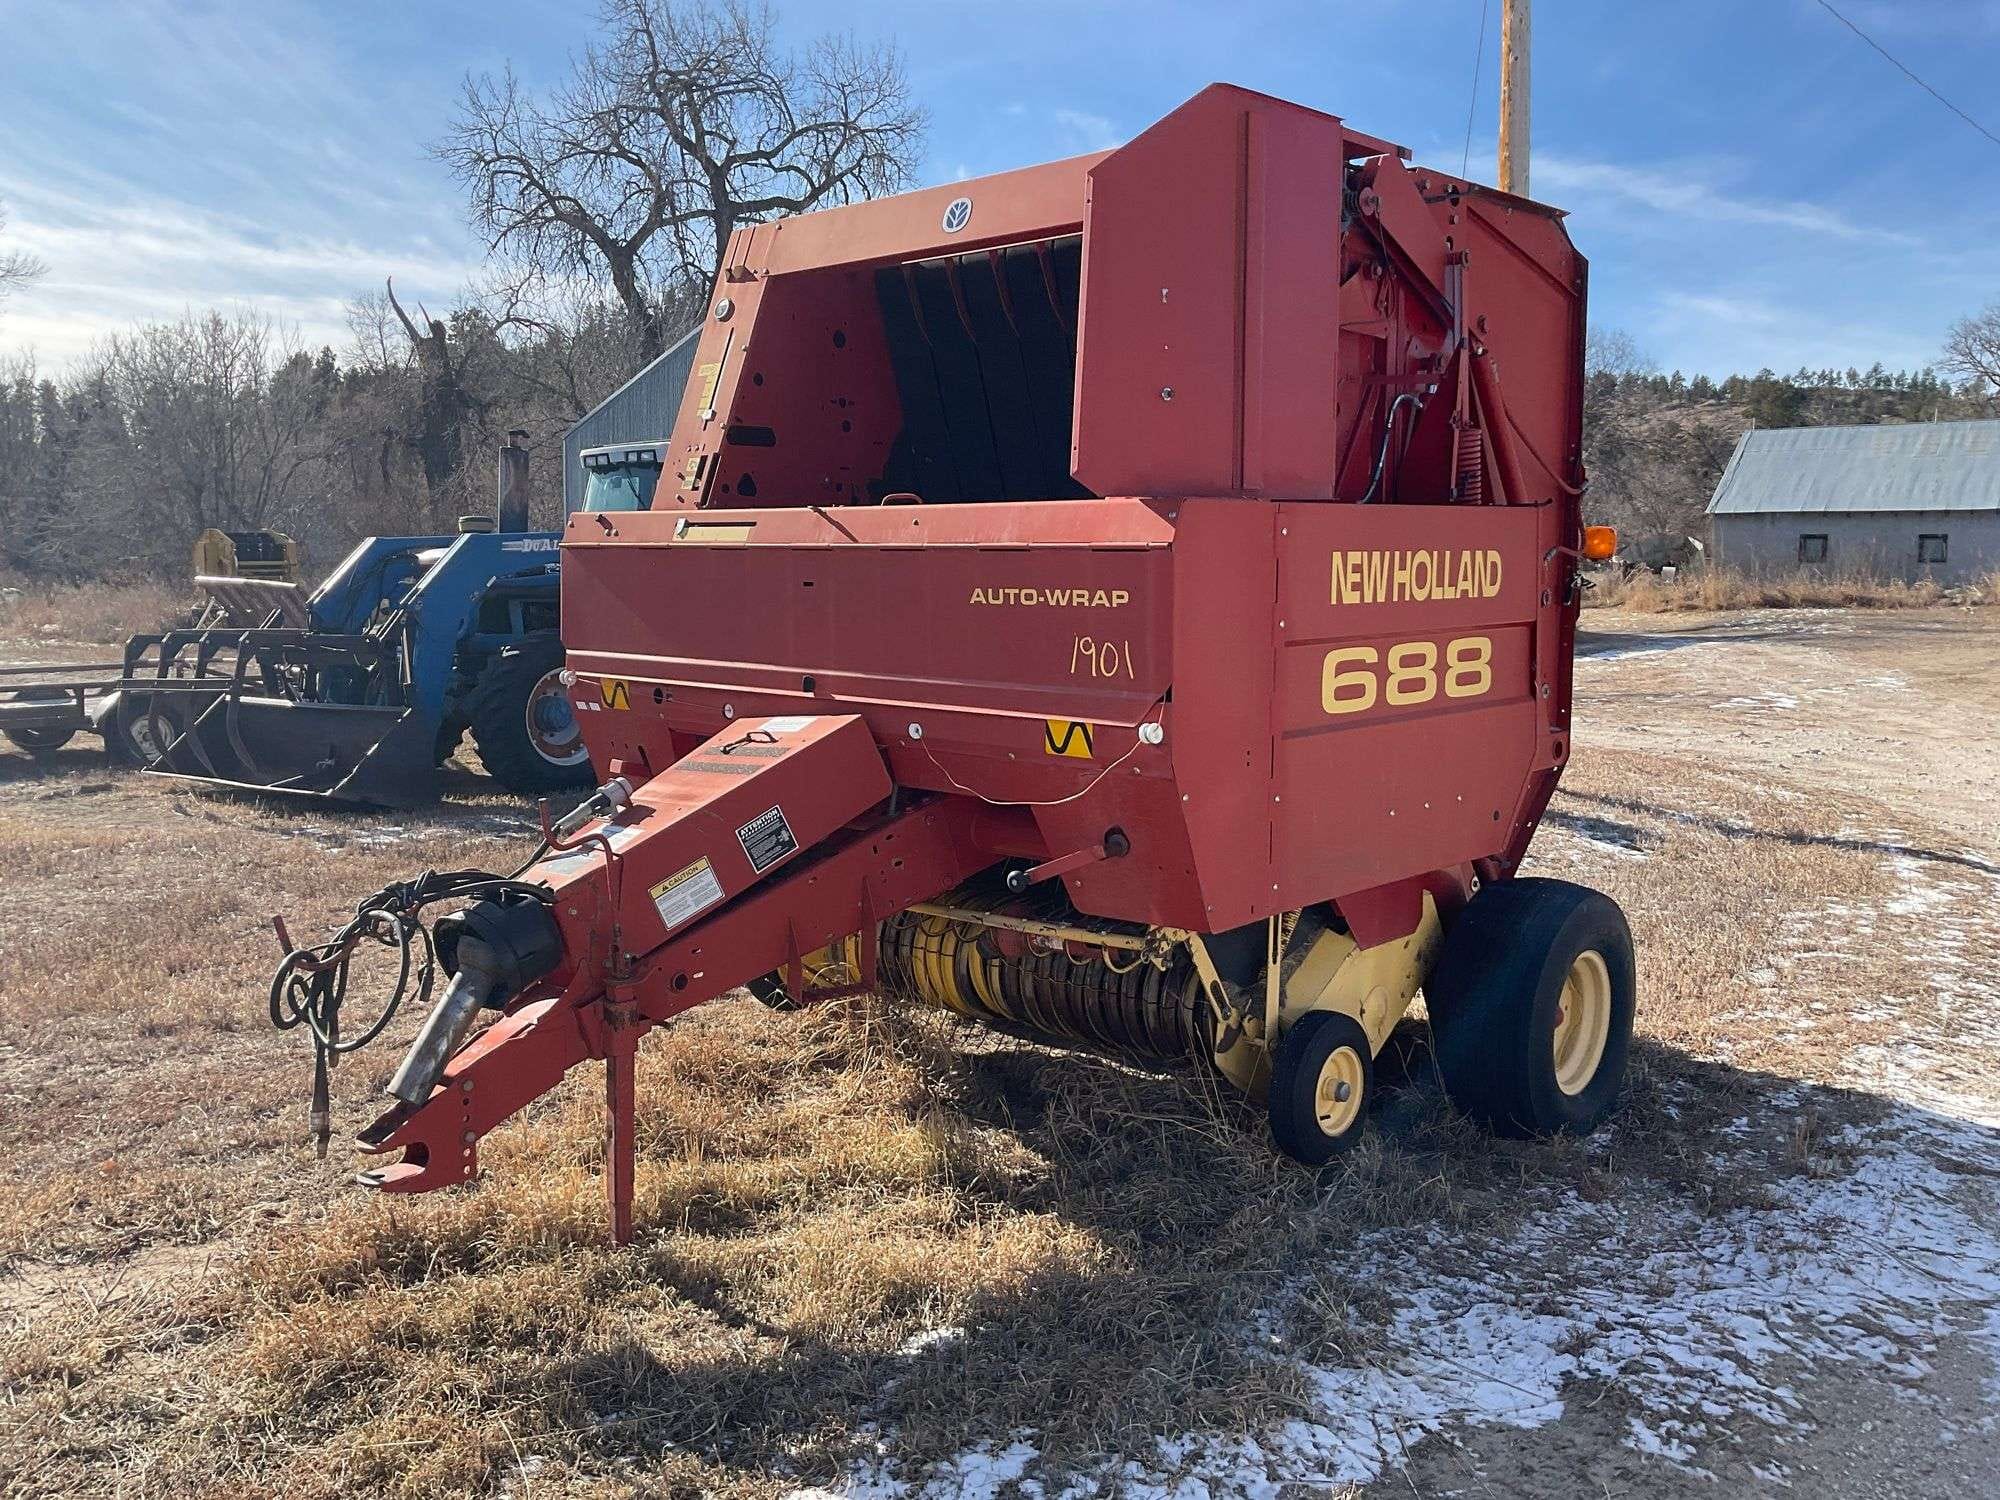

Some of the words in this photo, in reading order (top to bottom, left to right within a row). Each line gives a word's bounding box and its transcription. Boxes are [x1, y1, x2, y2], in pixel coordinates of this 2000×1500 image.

[1330, 551, 1390, 605] NEW
[1392, 549, 1502, 602] HOLLAND
[969, 587, 1130, 608] AUTO-WRAP
[1070, 633, 1134, 680] 1901
[1321, 636, 1493, 714] 688
[740, 808, 779, 836] ATTENTION
[668, 865, 699, 887] CAUTION
